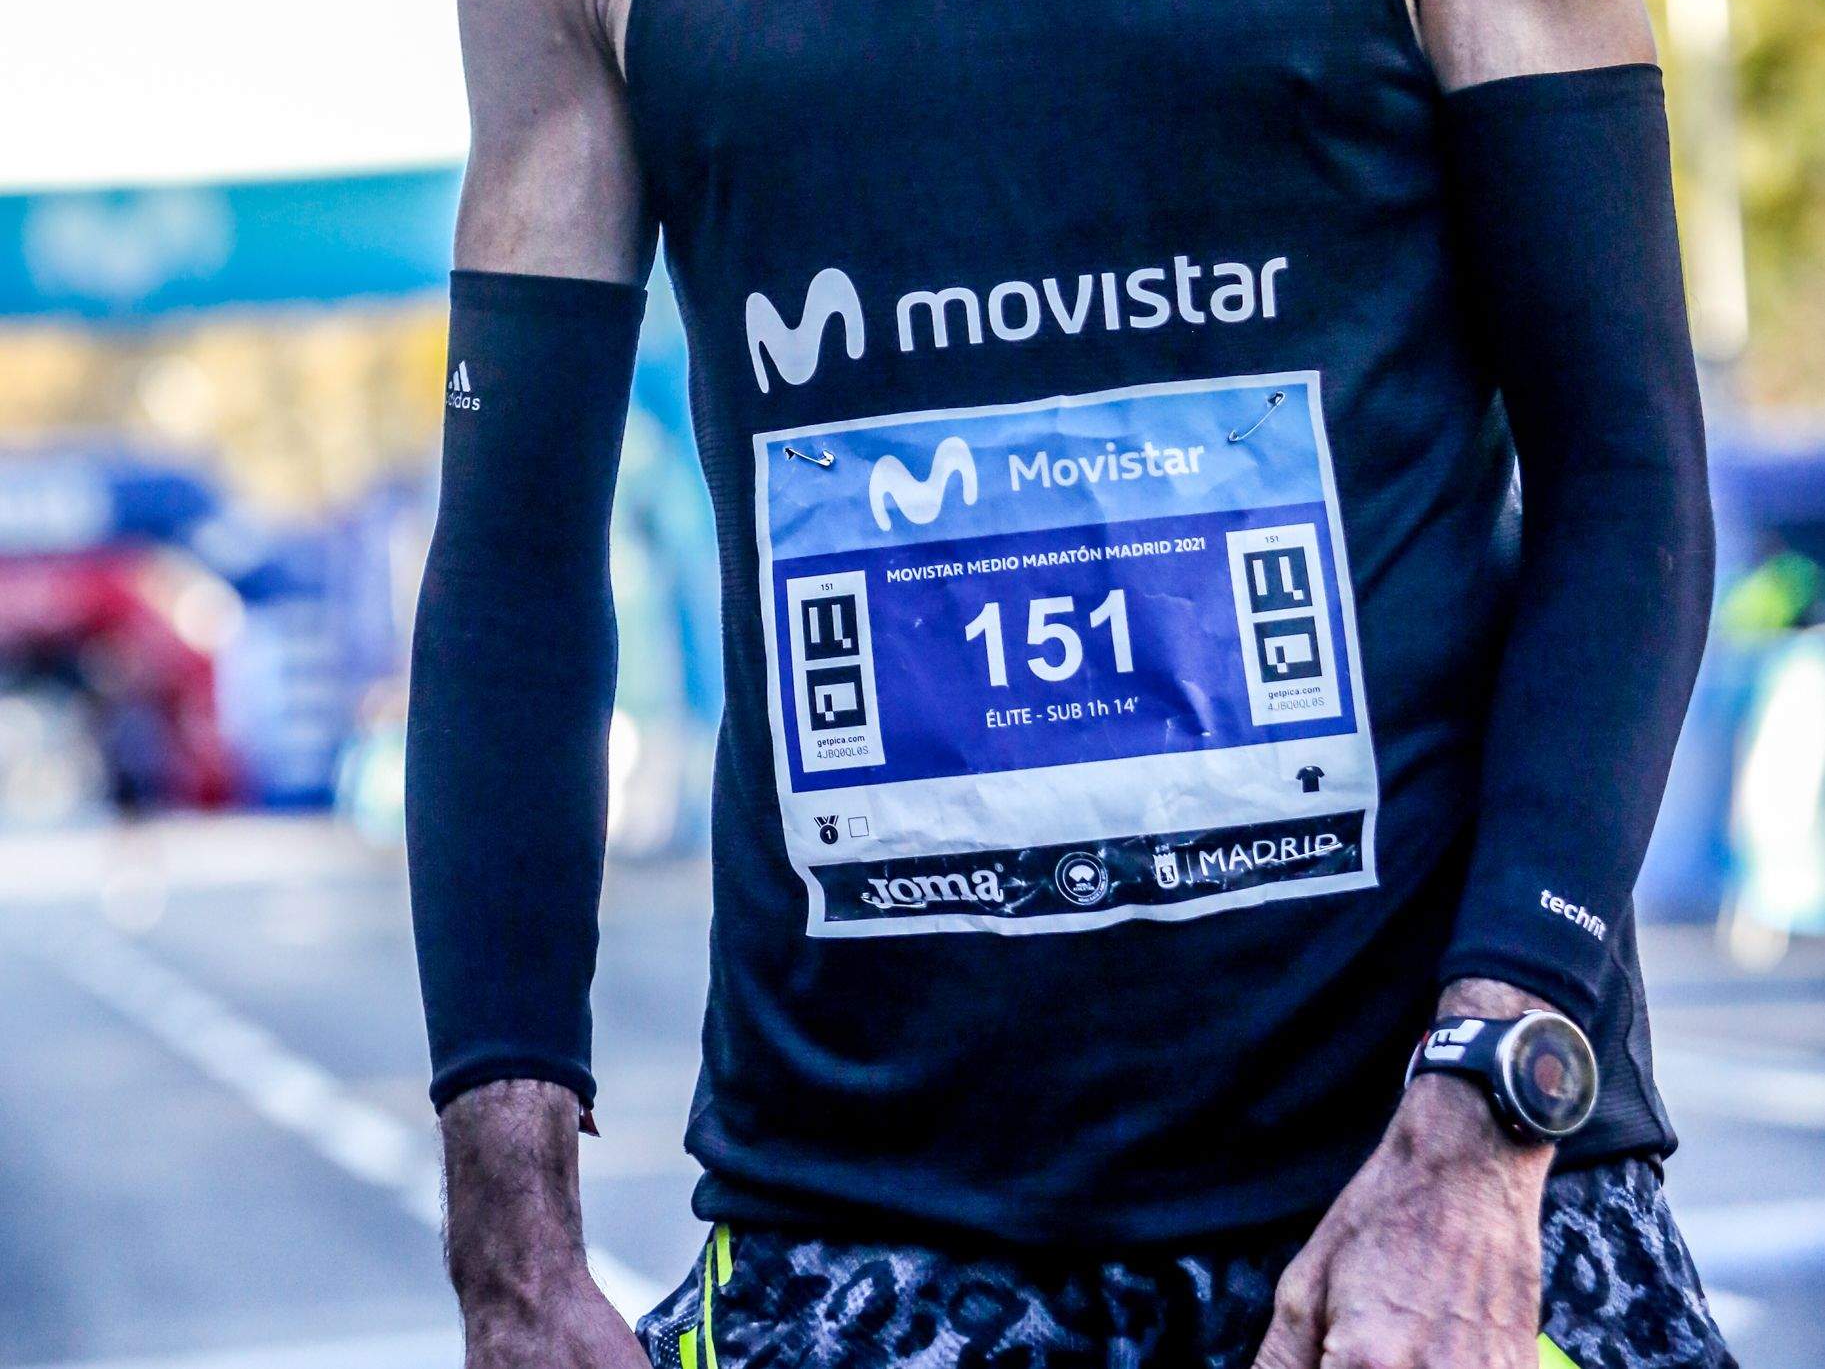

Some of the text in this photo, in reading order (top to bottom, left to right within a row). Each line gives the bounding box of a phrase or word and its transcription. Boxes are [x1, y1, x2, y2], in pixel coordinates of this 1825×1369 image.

[898, 256, 1287, 353] movistar
[1008, 440, 1205, 493] Movistar
[886, 537, 1206, 583] MOVISTAR MEDIO MARATÓN MADRID 2021
[1264, 535, 1280, 544] 151
[820, 582, 834, 592] 151
[965, 589, 1134, 687] 151
[986, 708, 1032, 729] ÉLITE
[1047, 702, 1083, 721] SUB
[1087, 699, 1109, 717] 1h
[1267, 686, 1321, 700] getpica.com
[816, 735, 865, 748] getpica.com
[1200, 833, 1343, 877] MADRID
[1540, 889, 1606, 942] techfit
